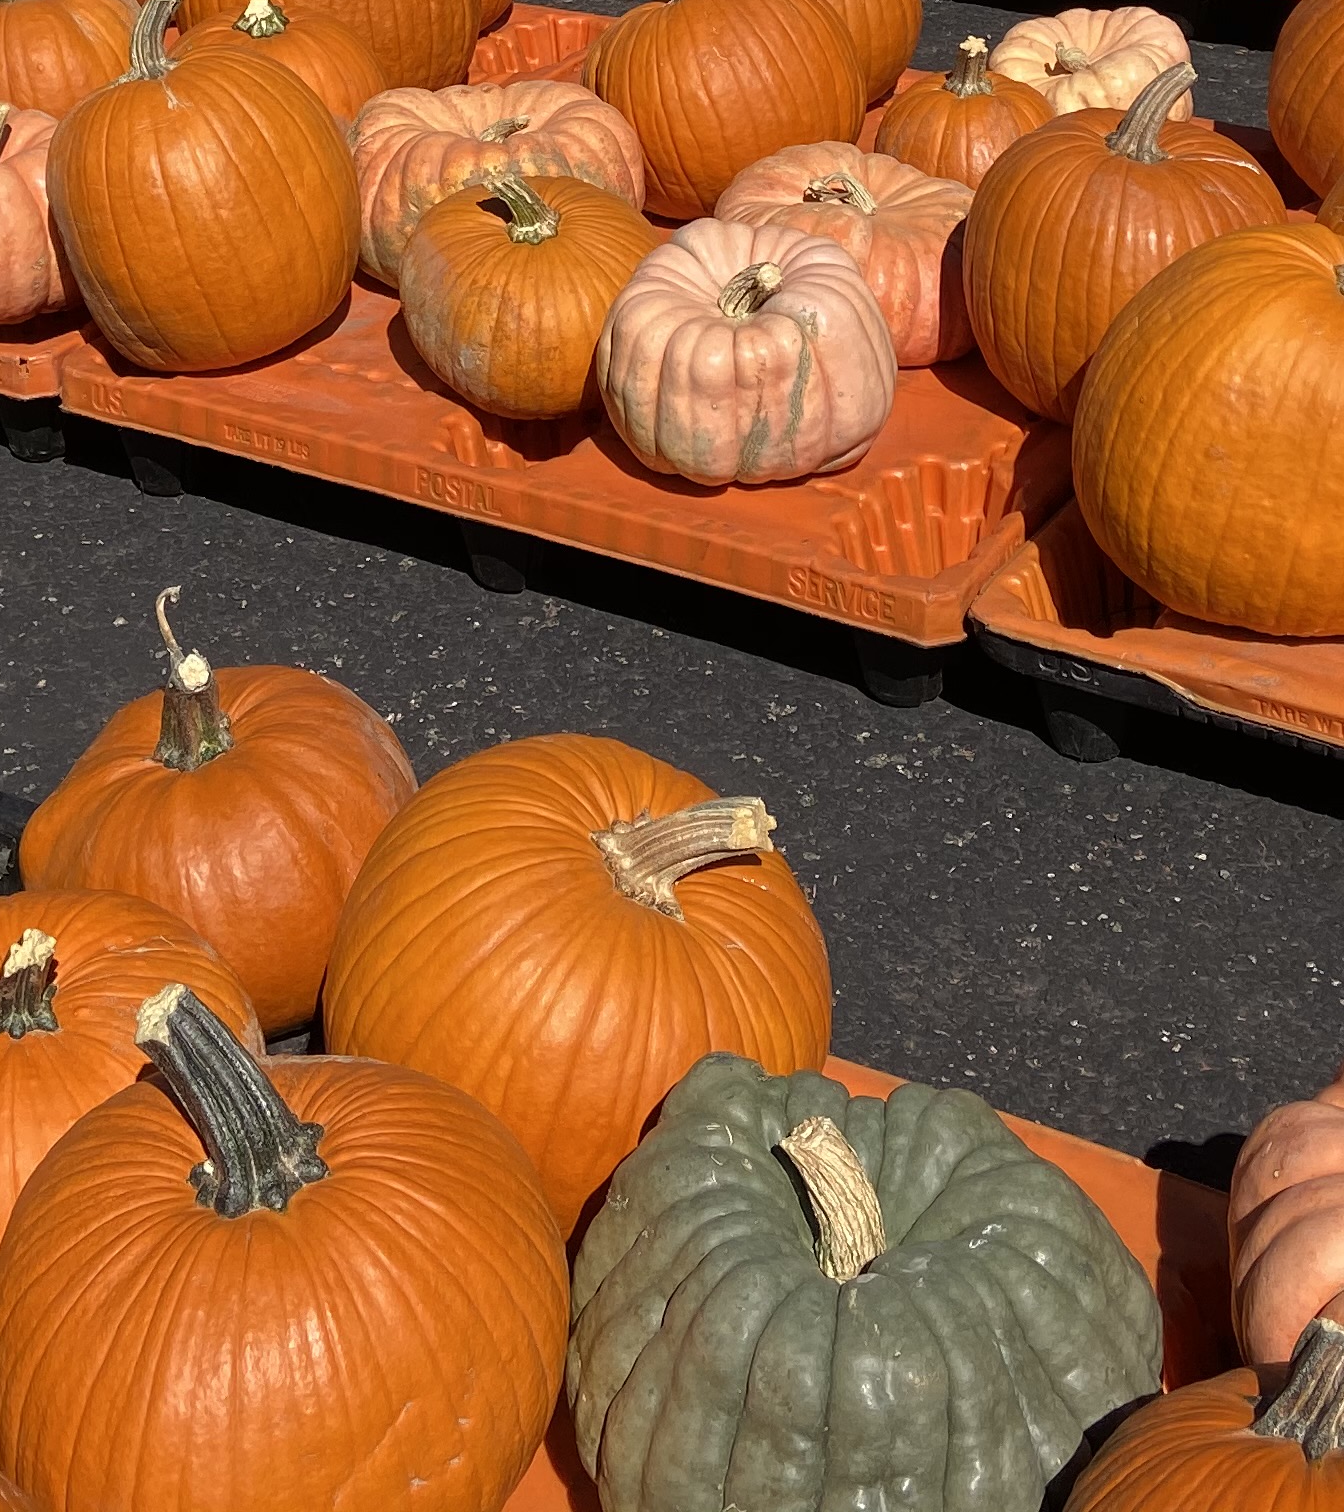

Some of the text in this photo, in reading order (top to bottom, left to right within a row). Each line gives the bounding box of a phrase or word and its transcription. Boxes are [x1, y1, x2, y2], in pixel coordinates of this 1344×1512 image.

[90, 383, 128, 417] U.S.
[413, 465, 503, 517] POSTAL
[787, 566, 897, 625] SERVICE
[1036, 654, 1100, 687] U.S.
[1251, 696, 1310, 728] TARE
